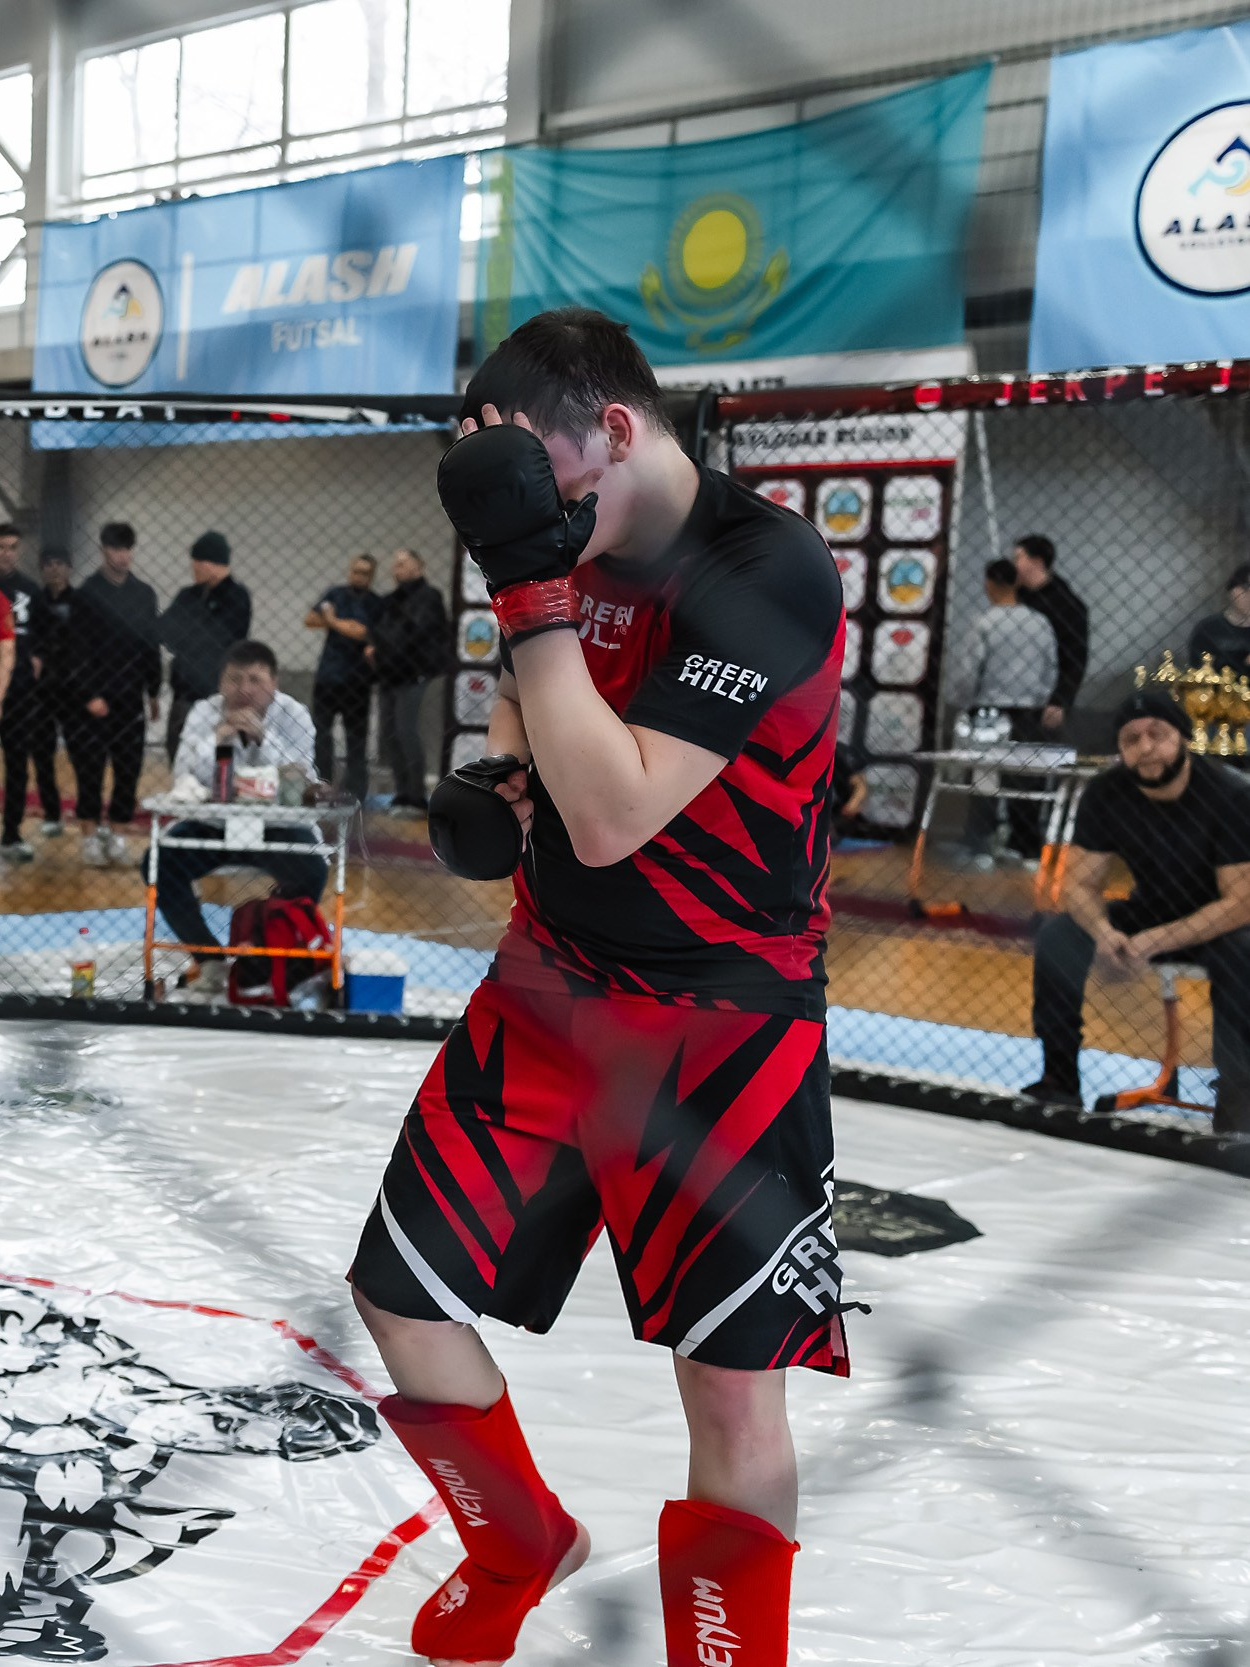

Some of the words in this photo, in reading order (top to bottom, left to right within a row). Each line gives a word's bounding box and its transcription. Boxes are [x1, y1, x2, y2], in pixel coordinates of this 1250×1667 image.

[1162, 213, 1250, 237] ALA
[221, 242, 419, 314] ALASH
[271, 316, 362, 352] FUTSAL
[994, 361, 1166, 406] JEKPE
[579, 594, 635, 626] REEN
[678, 666, 745, 704] HILL
[684, 654, 769, 692] GREEN
[427, 1458, 490, 1527] VENUM
[691, 1576, 742, 1667] ENUM
